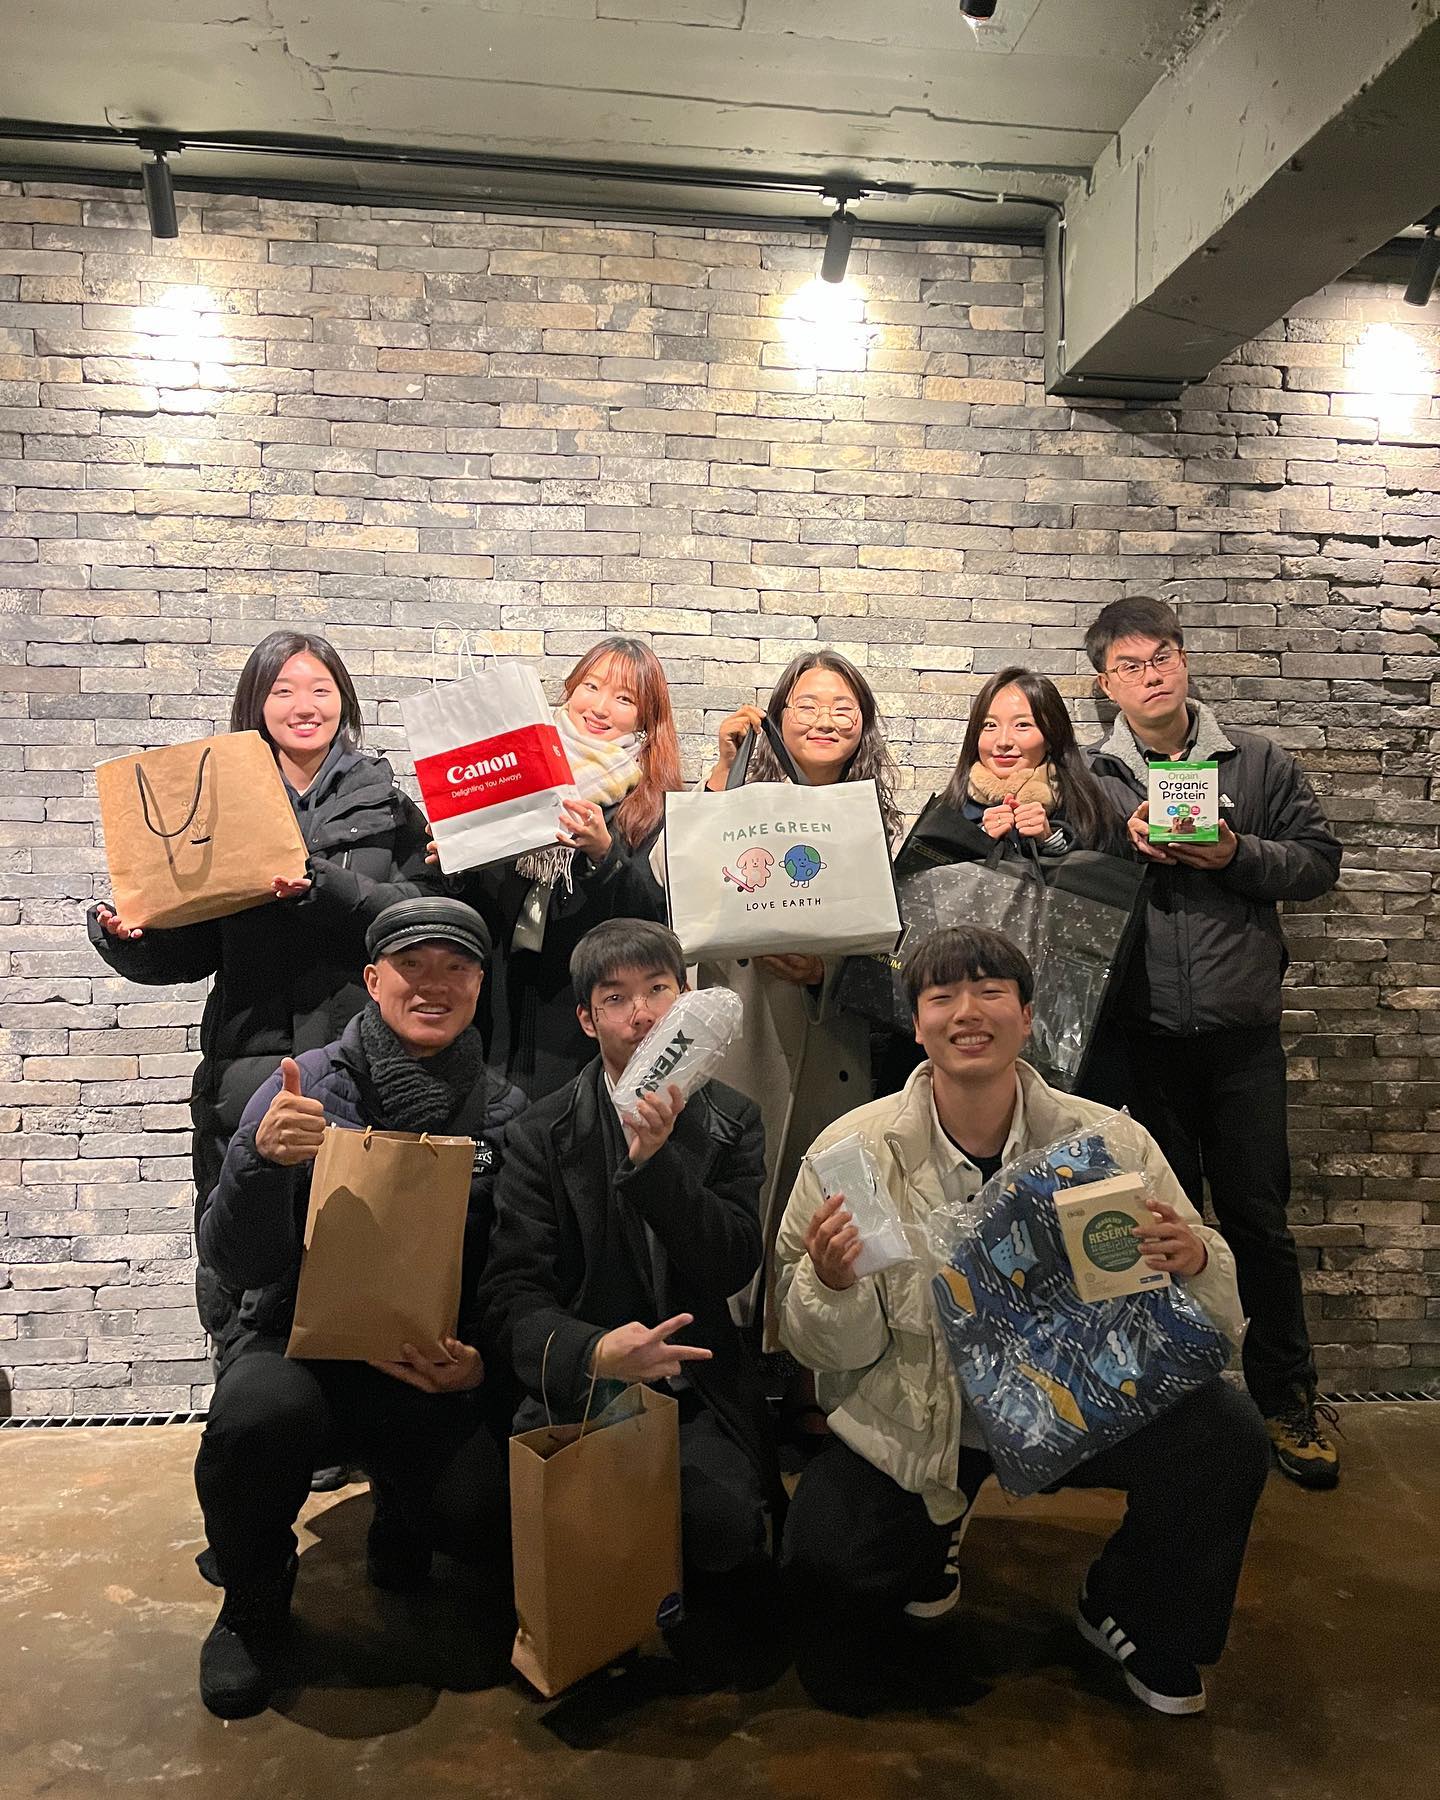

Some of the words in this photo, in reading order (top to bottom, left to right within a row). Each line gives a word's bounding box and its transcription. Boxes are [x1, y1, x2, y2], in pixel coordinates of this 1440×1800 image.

[446, 751, 518, 784] Canon
[451, 783, 485, 799] Delighting
[484, 779, 498, 790] You
[498, 773, 522, 786] Always
[1158, 780, 1209, 792] Organic
[1162, 791, 1206, 800] Protein
[722, 823, 769, 842] MAKE
[774, 821, 832, 834] GREEN
[746, 901, 776, 912] LOVE
[782, 897, 822, 908] EARTH
